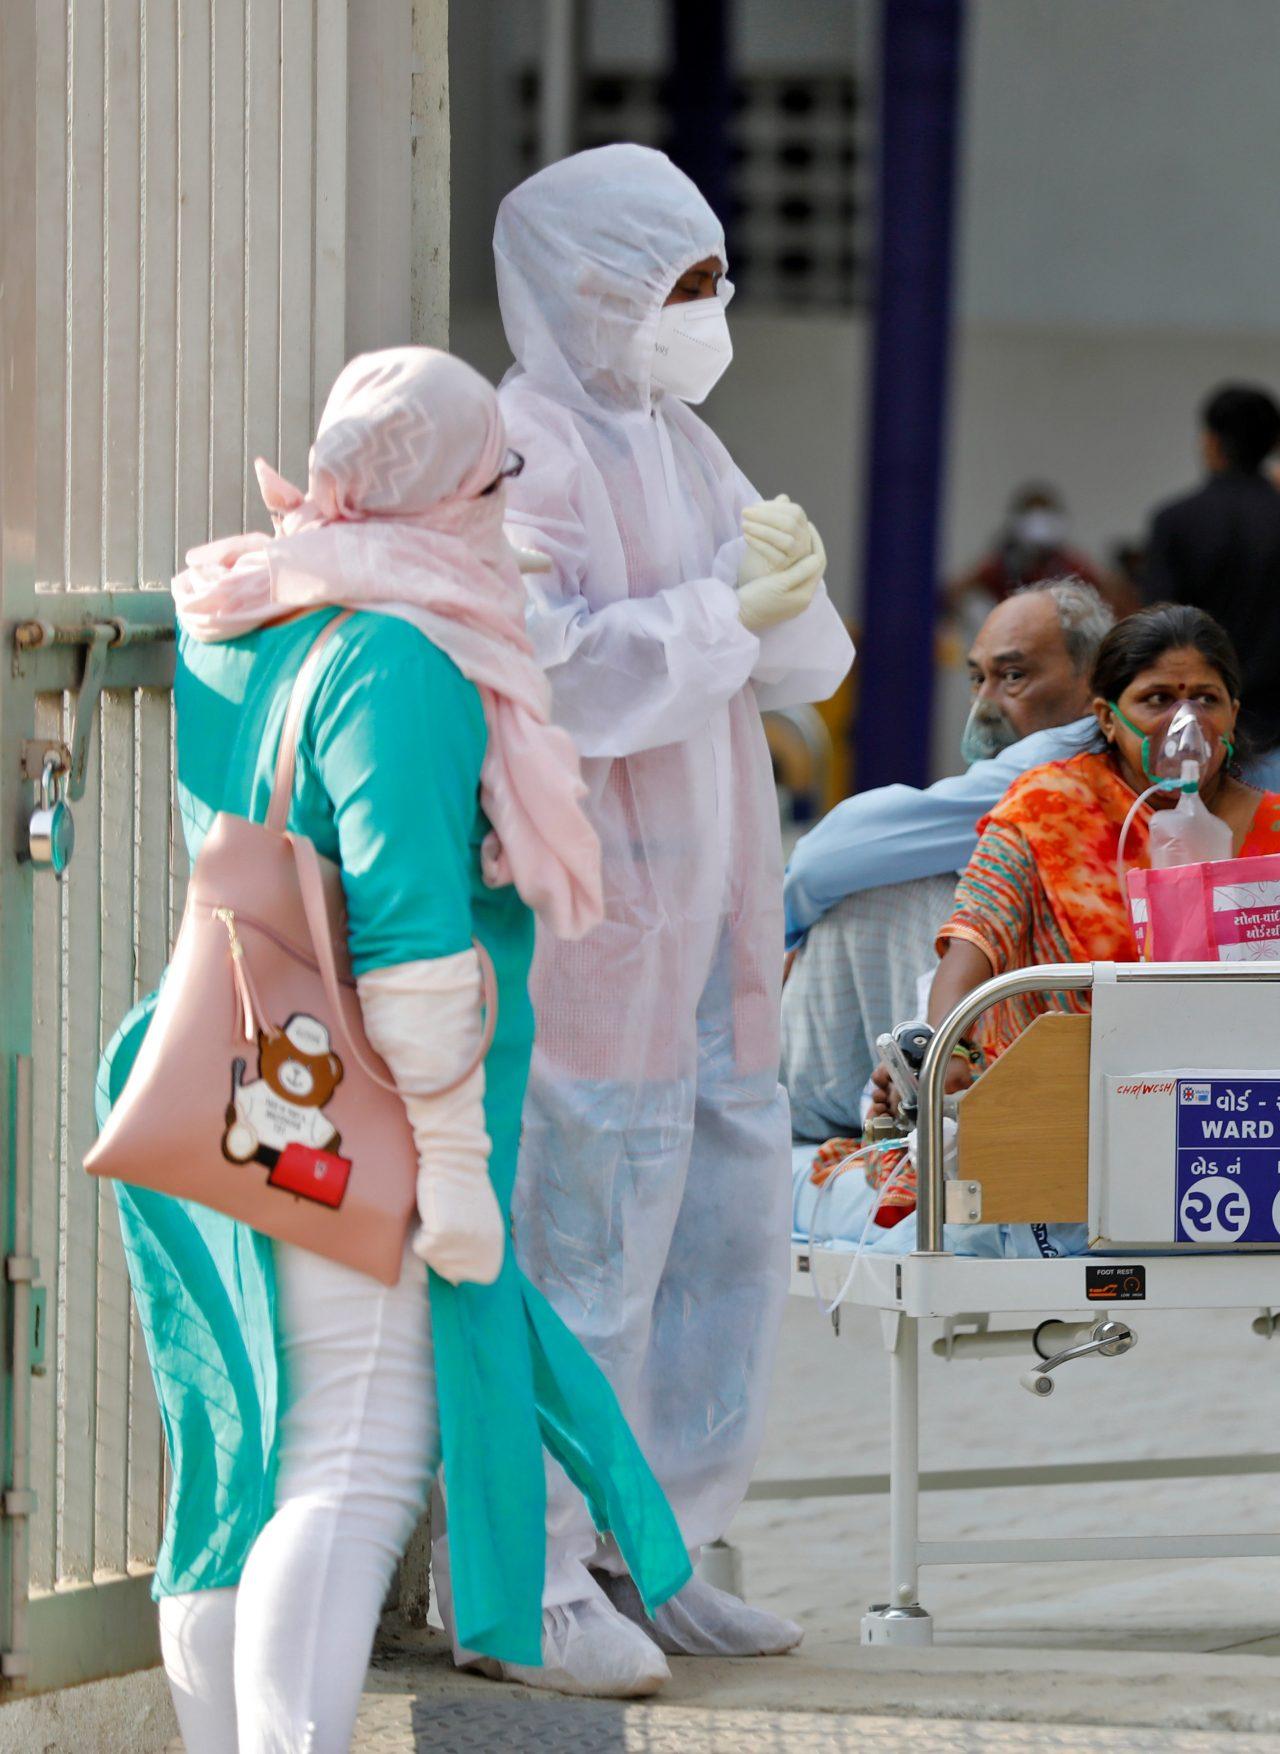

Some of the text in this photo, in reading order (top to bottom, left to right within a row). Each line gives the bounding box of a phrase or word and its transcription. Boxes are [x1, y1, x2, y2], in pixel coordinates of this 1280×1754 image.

[1216, 1089, 1252, 1112] વોર્ડ
[1201, 1120, 1274, 1139] WARD
[1190, 1156, 1241, 1175] બેડ નં
